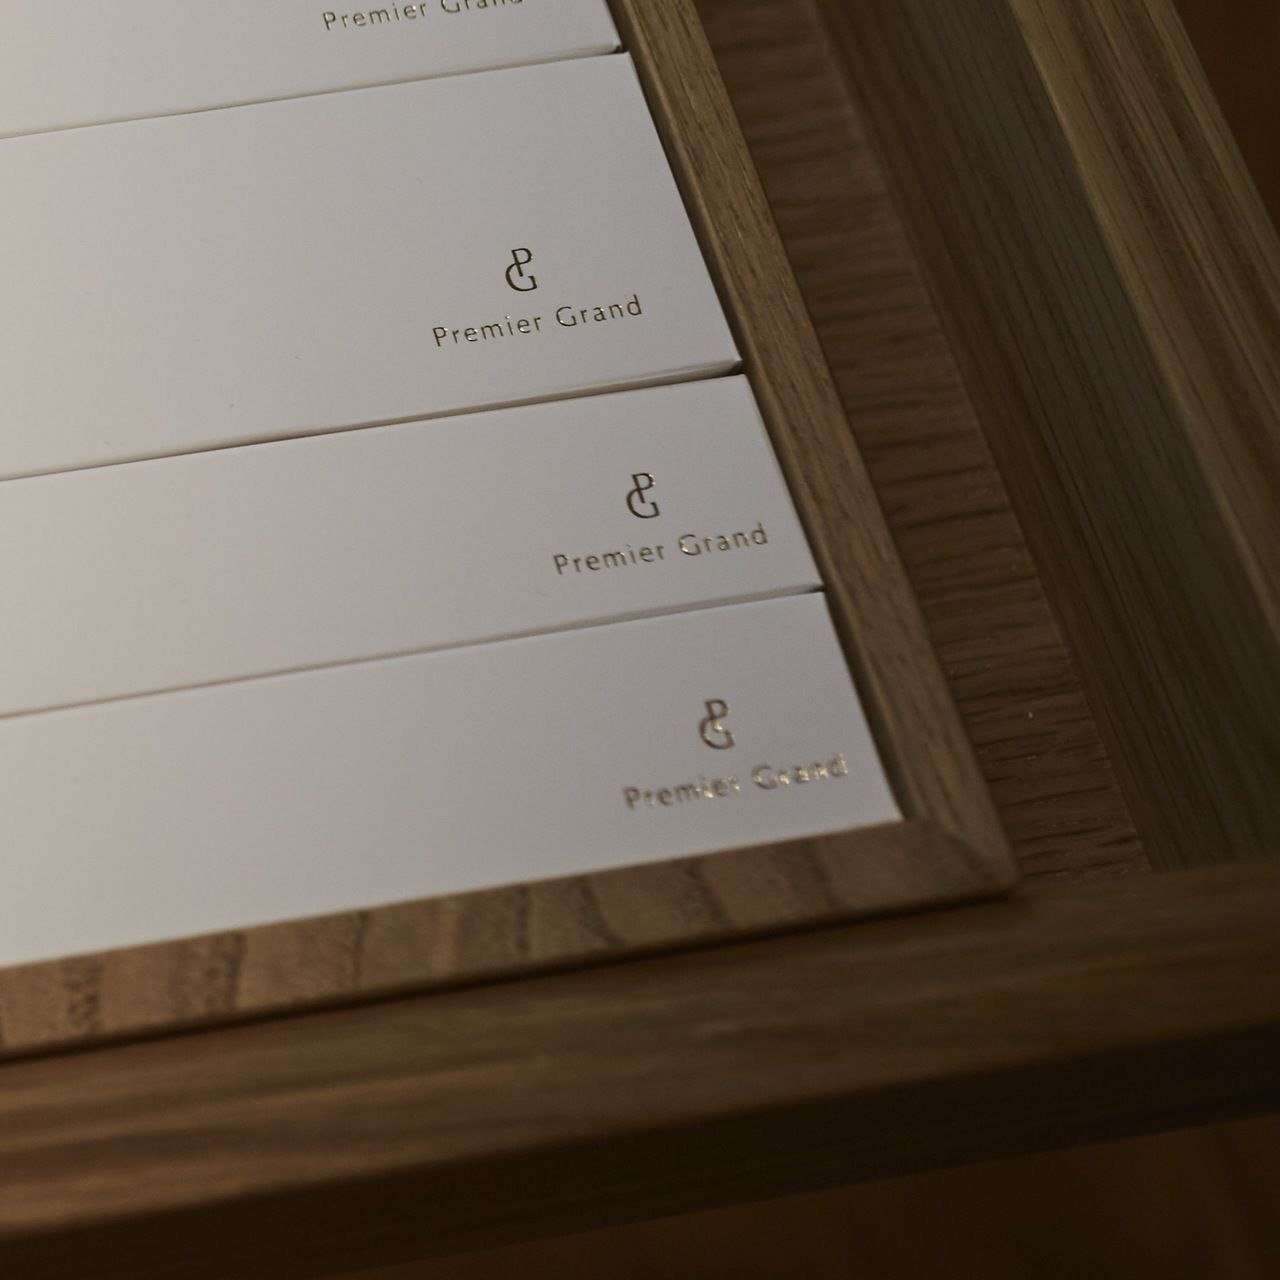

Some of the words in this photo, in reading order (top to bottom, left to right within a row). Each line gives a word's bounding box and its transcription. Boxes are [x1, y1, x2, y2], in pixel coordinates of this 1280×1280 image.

[322, 1, 428, 31] Premier
[432, 313, 543, 348] Premier
[555, 293, 643, 328] Grand
[552, 542, 666, 576] Premier
[677, 522, 769, 558] Grand
[623, 773, 742, 812] Premier
[750, 752, 850, 791] Grand
